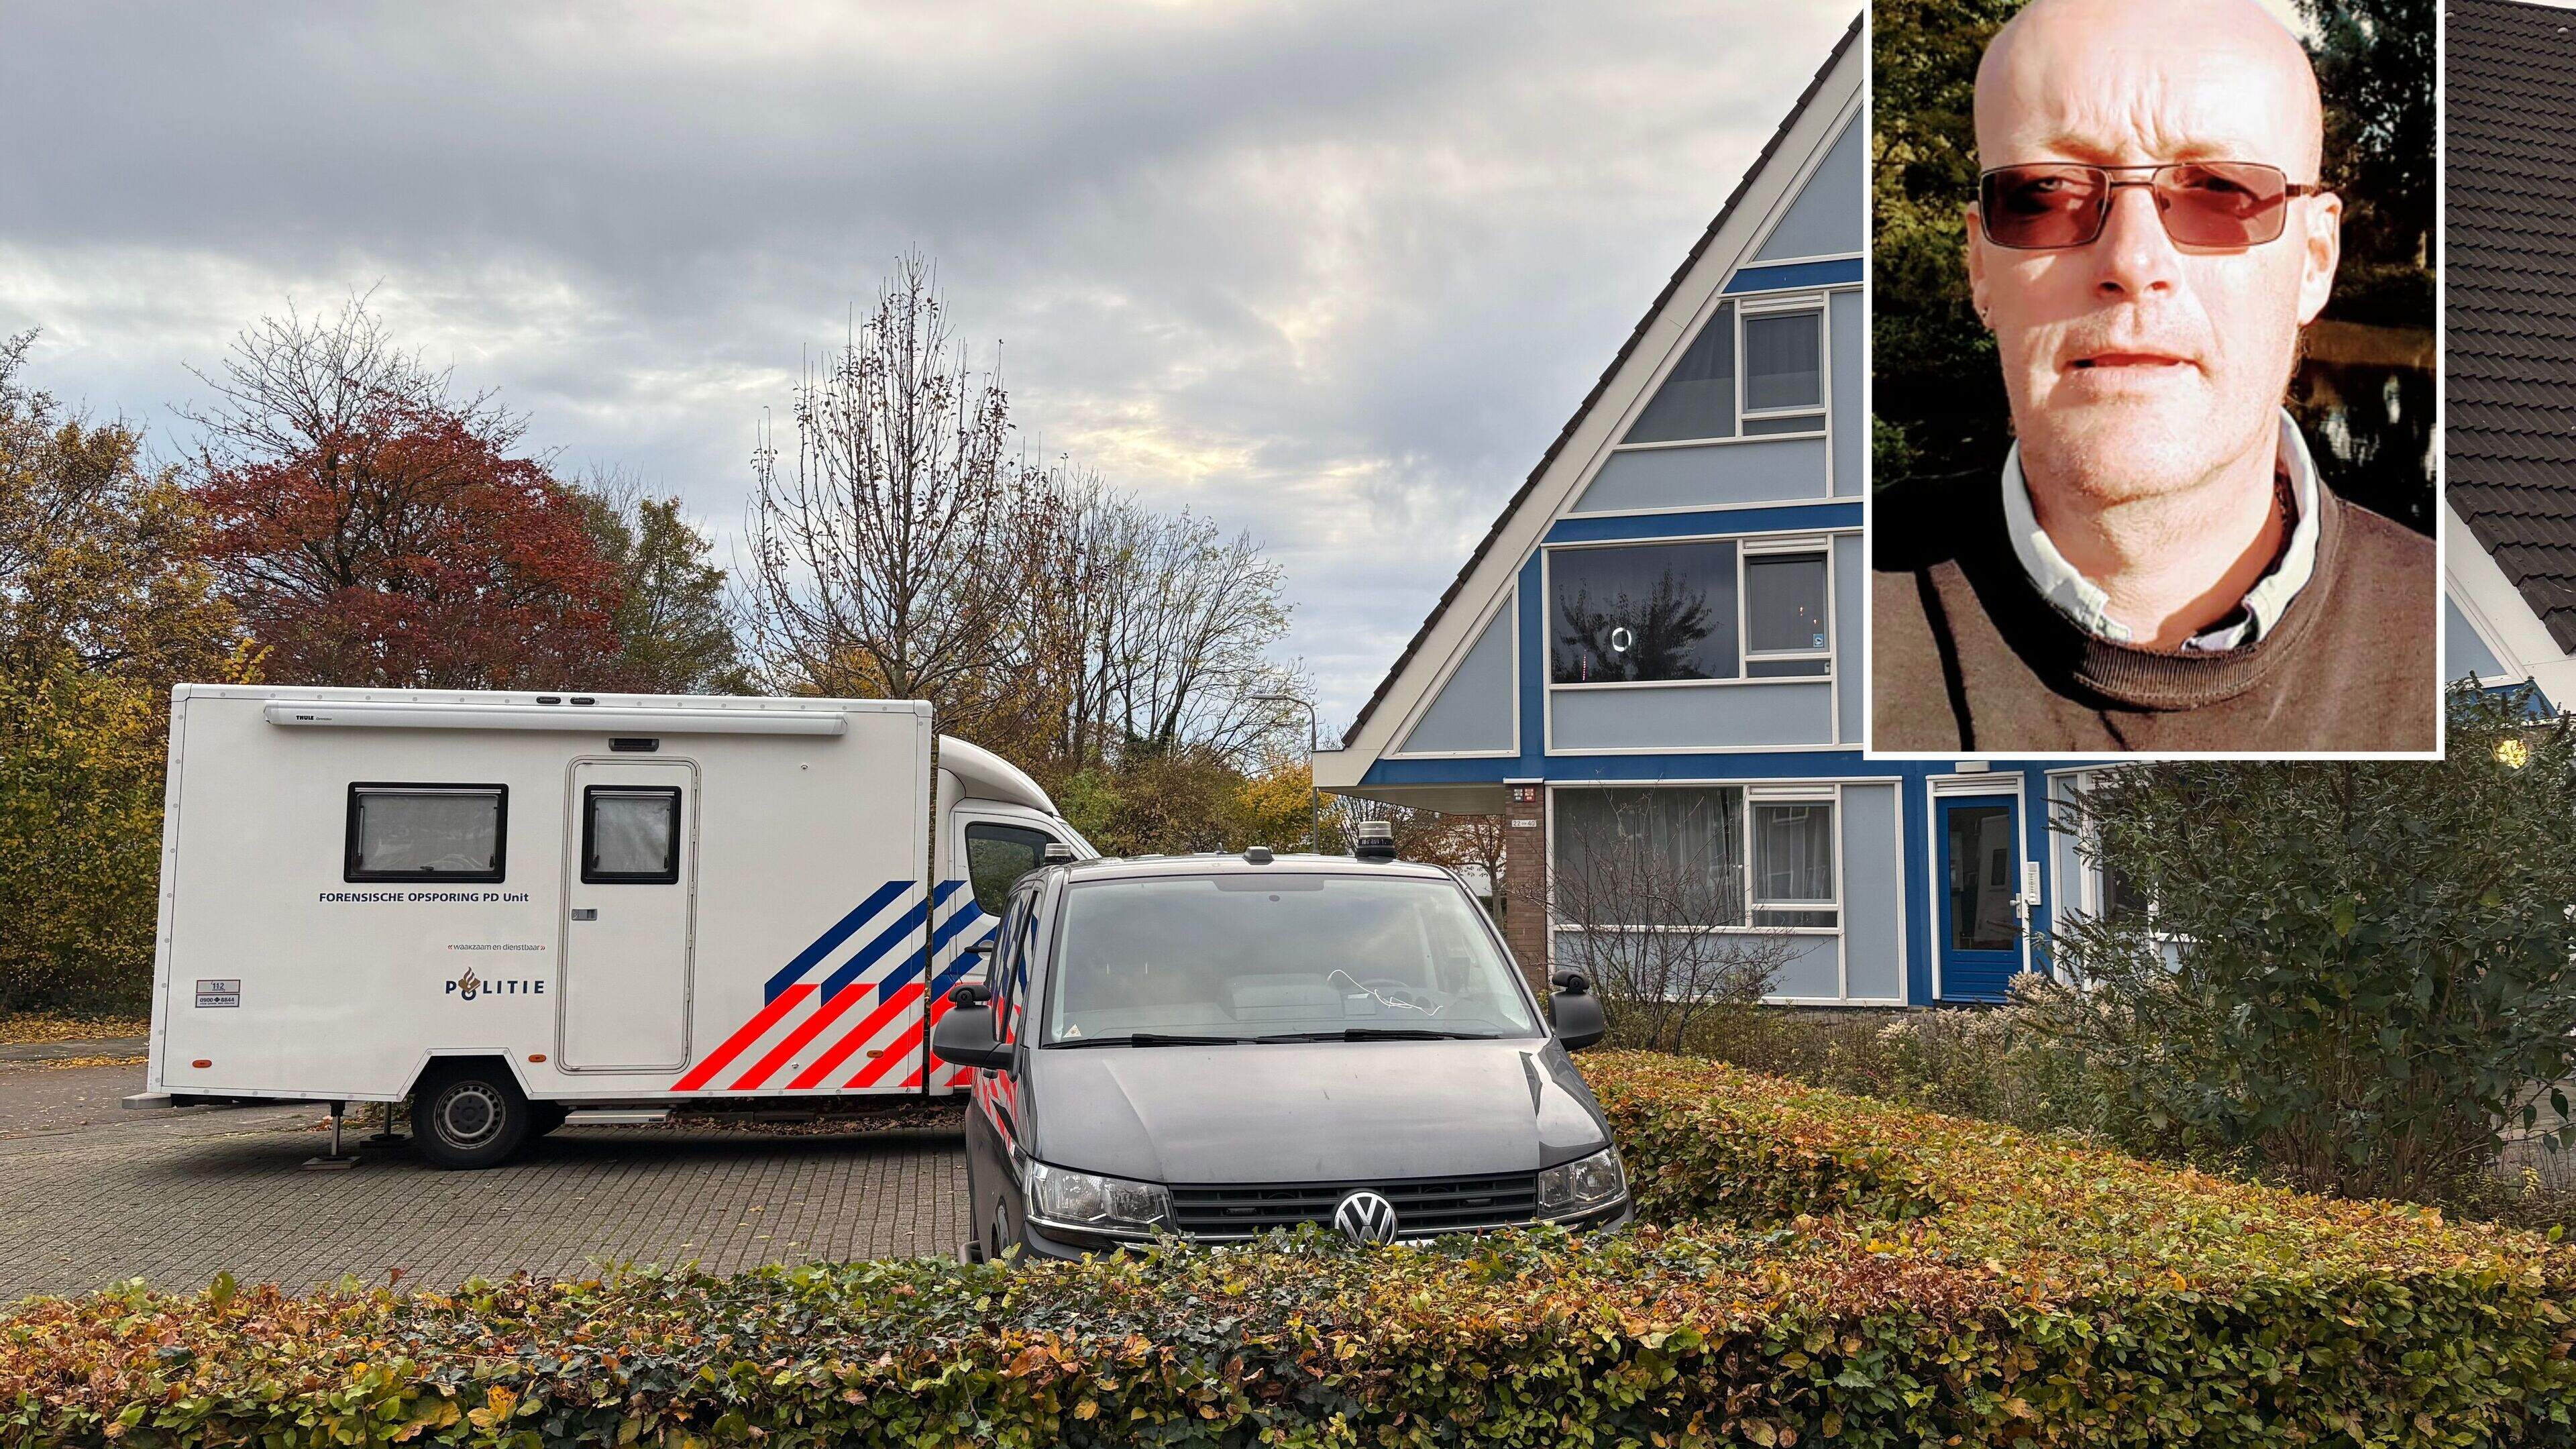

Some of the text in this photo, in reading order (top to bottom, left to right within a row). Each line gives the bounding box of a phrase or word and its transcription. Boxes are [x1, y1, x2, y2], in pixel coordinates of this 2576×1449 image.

[319, 893, 529, 902] FORENSISCHE OPSPORING PD Unit
[445, 981, 544, 1000] POLITIE
